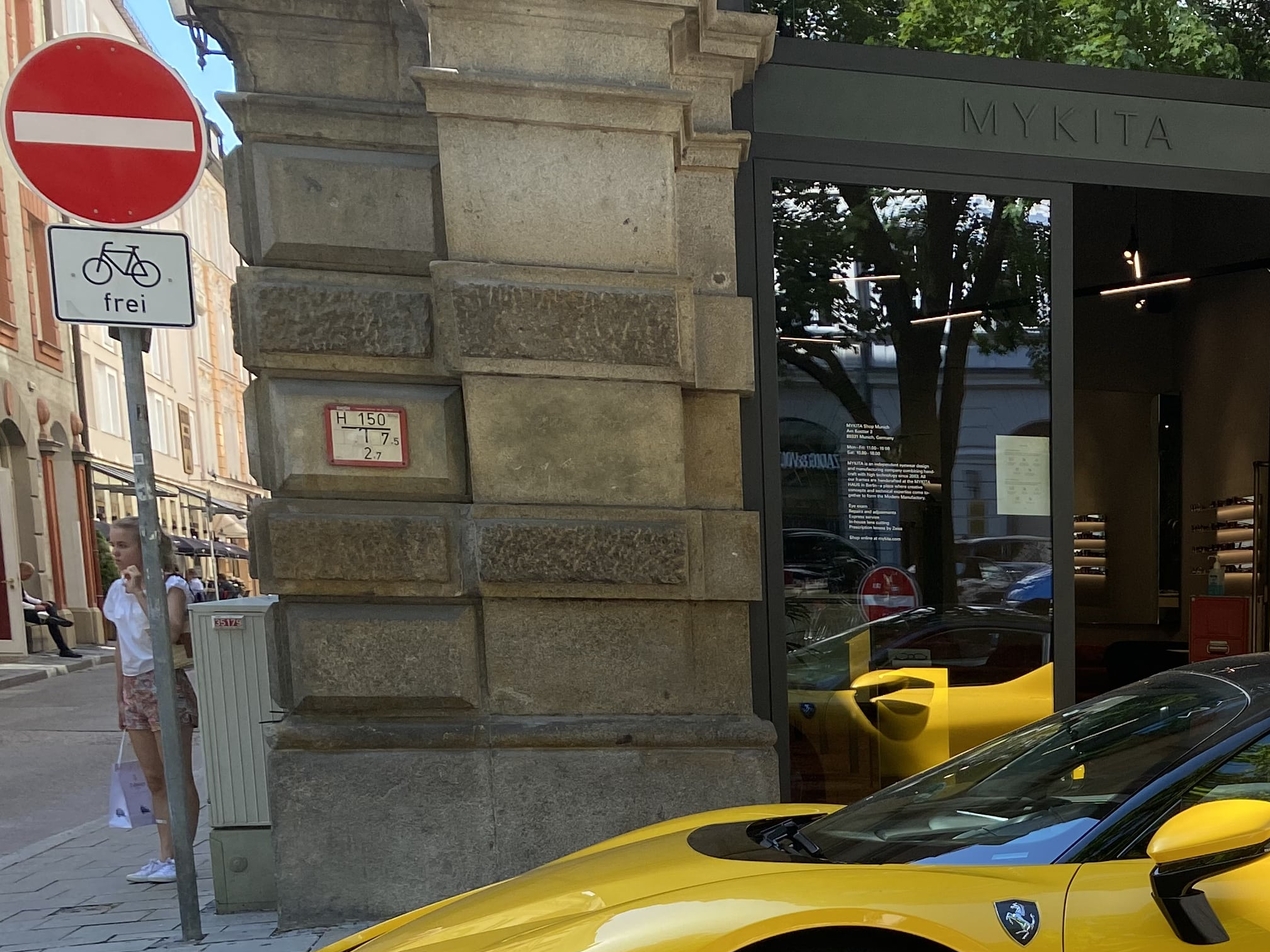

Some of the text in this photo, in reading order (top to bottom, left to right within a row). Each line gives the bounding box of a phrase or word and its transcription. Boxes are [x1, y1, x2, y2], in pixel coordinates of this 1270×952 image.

[962, 97, 1172, 150] MYKITA
[103, 292, 146, 313] frei
[336, 411, 386, 426] H 150
